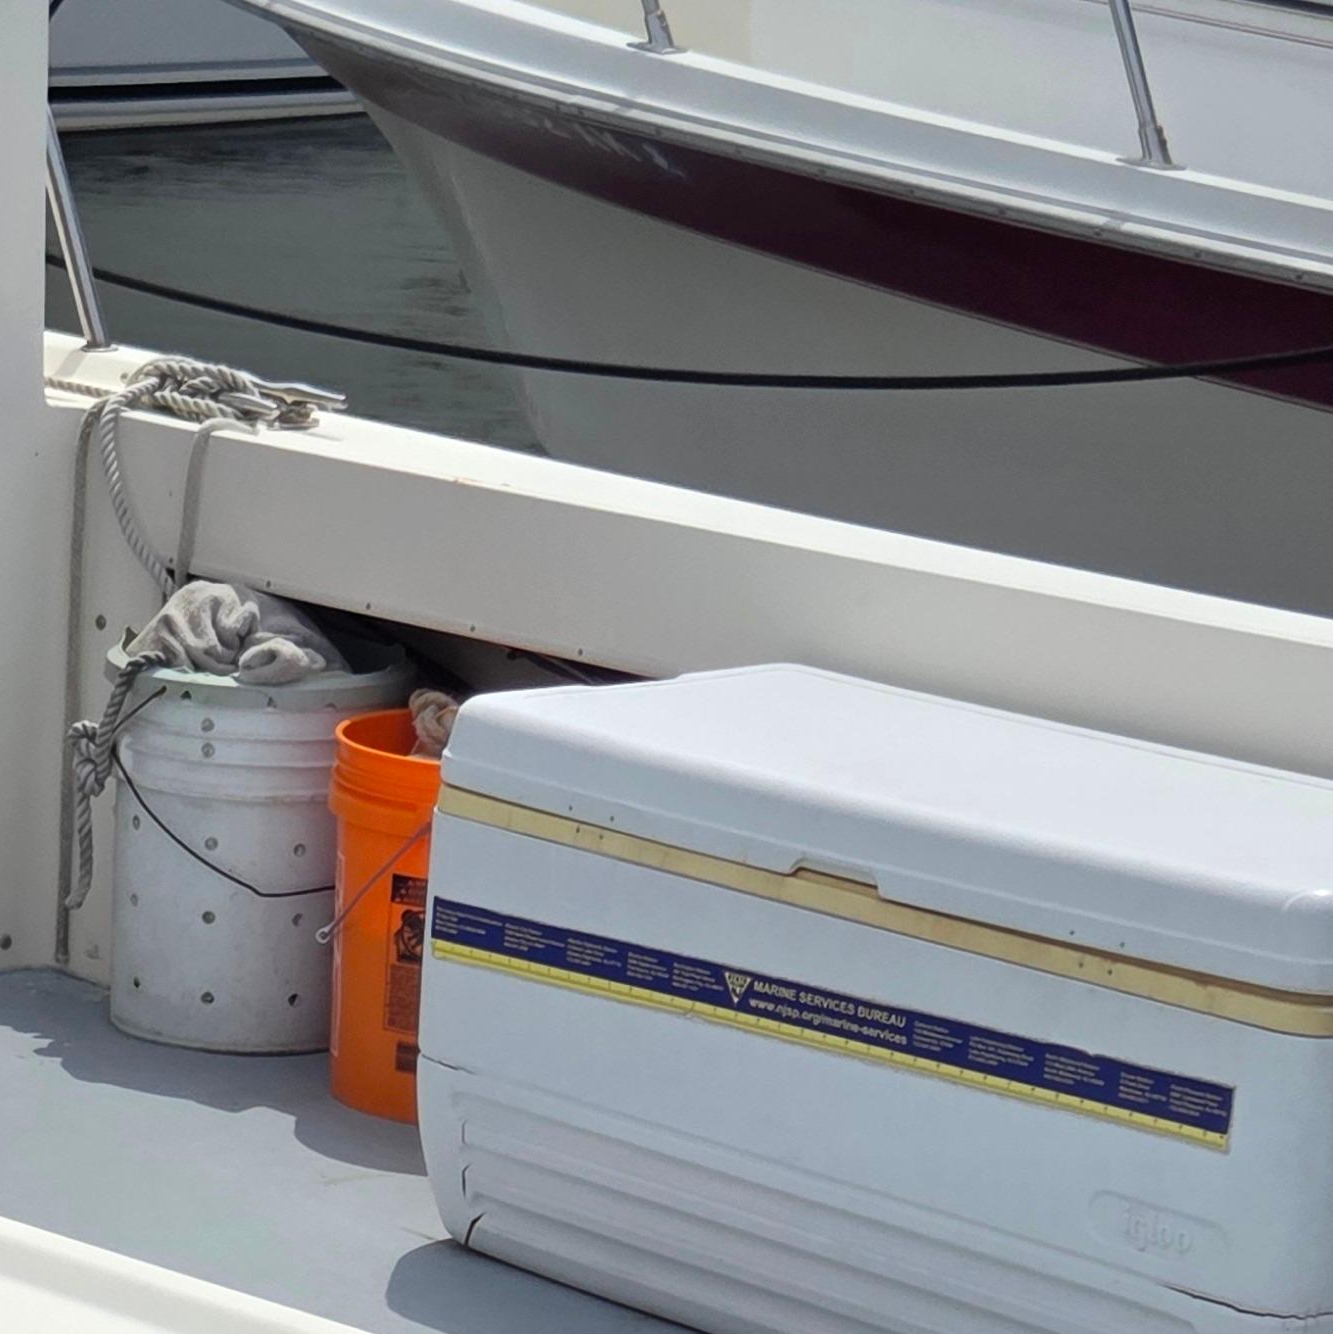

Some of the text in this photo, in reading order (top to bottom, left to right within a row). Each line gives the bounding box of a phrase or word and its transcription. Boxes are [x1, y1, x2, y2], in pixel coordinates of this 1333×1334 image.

[748, 998, 908, 1045] www.njsp.org/marine-services
[753, 980, 796, 1001] MARINE
[799, 991, 855, 1016] SERVICES
[857, 1005, 907, 1029] BUREAU
